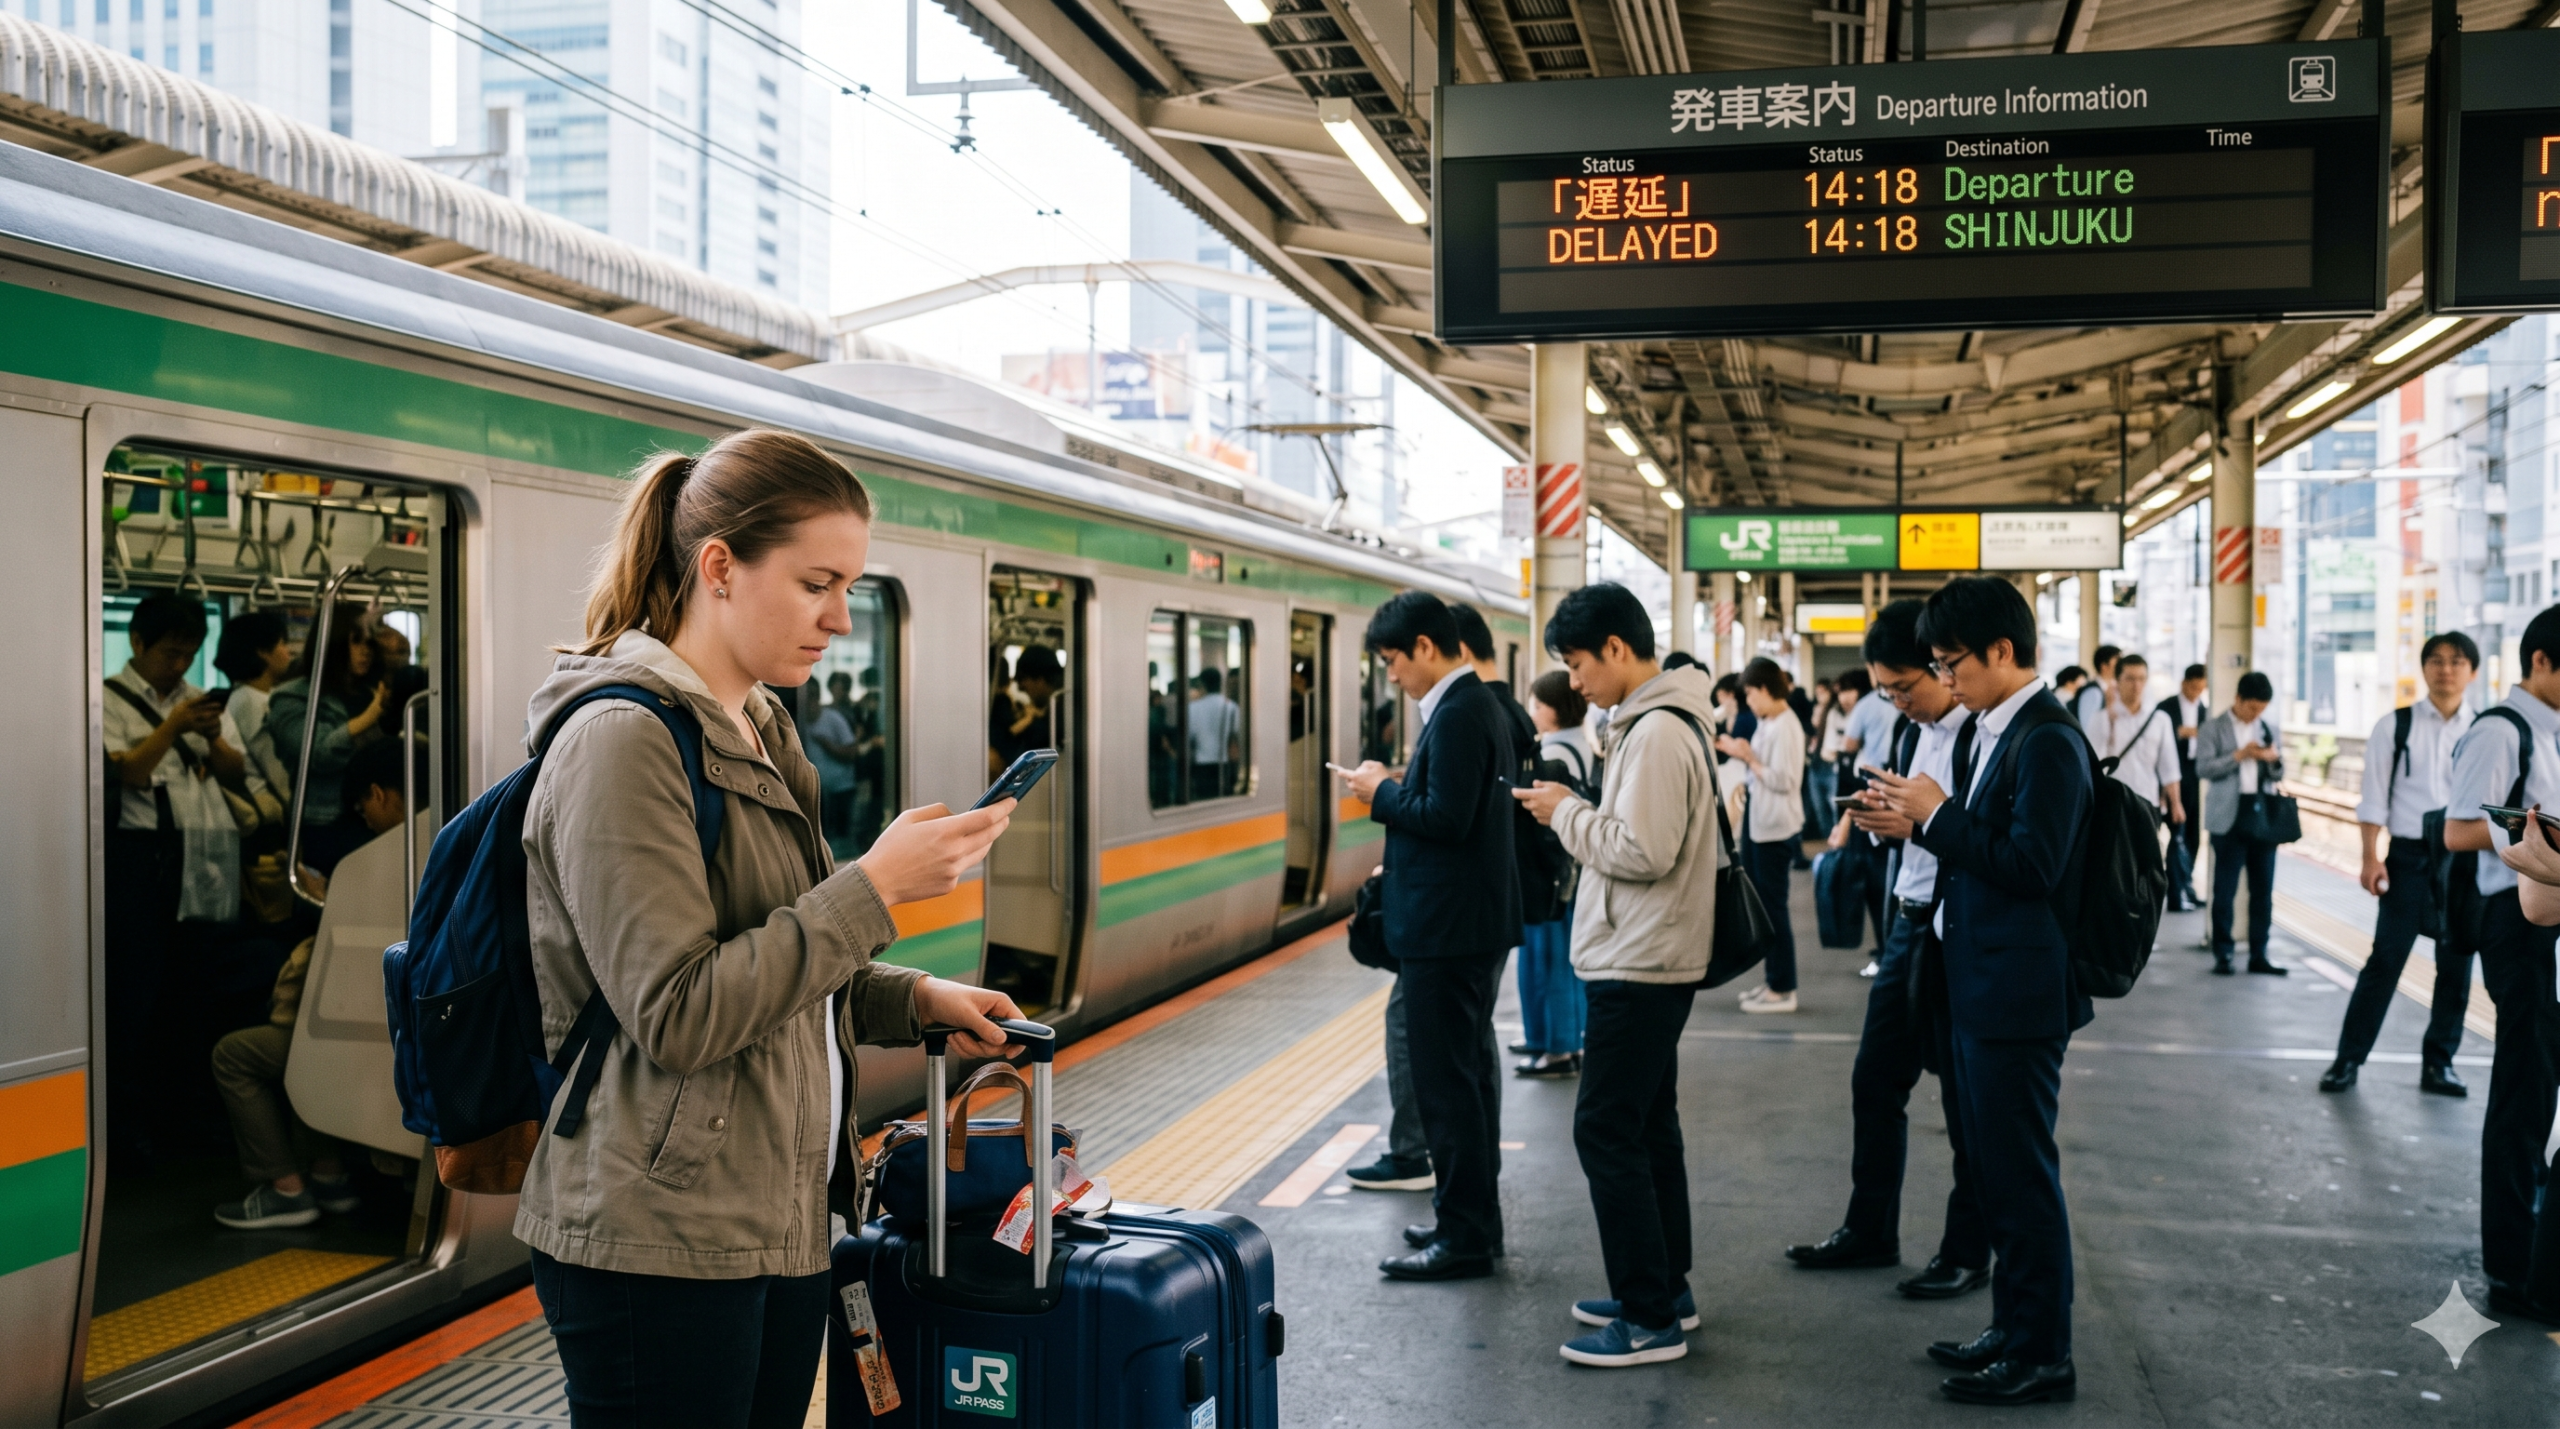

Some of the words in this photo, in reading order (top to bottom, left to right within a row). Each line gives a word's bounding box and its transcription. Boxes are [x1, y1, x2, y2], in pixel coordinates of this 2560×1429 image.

[1670, 80, 1856, 134] 発車案内
[1876, 93, 1997, 126] Departure
[2004, 83, 2148, 115] Information
[1809, 146, 1864, 164] Status
[1945, 138, 2050, 158] Destination
[2206, 128, 2253, 147] Time
[1582, 156, 1635, 174] Status
[1944, 165, 2135, 205] Departure
[1804, 167, 1918, 208] 14:18
[1548, 223, 1719, 264] DELAYED
[1804, 214, 1918, 254] 14:18
[1944, 207, 2134, 249] SHINJUKU
[1719, 519, 1774, 551] JR
[951, 1355, 1009, 1397] JR
[954, 1394, 973, 1406] JR
[973, 1396, 1005, 1411] PASS
